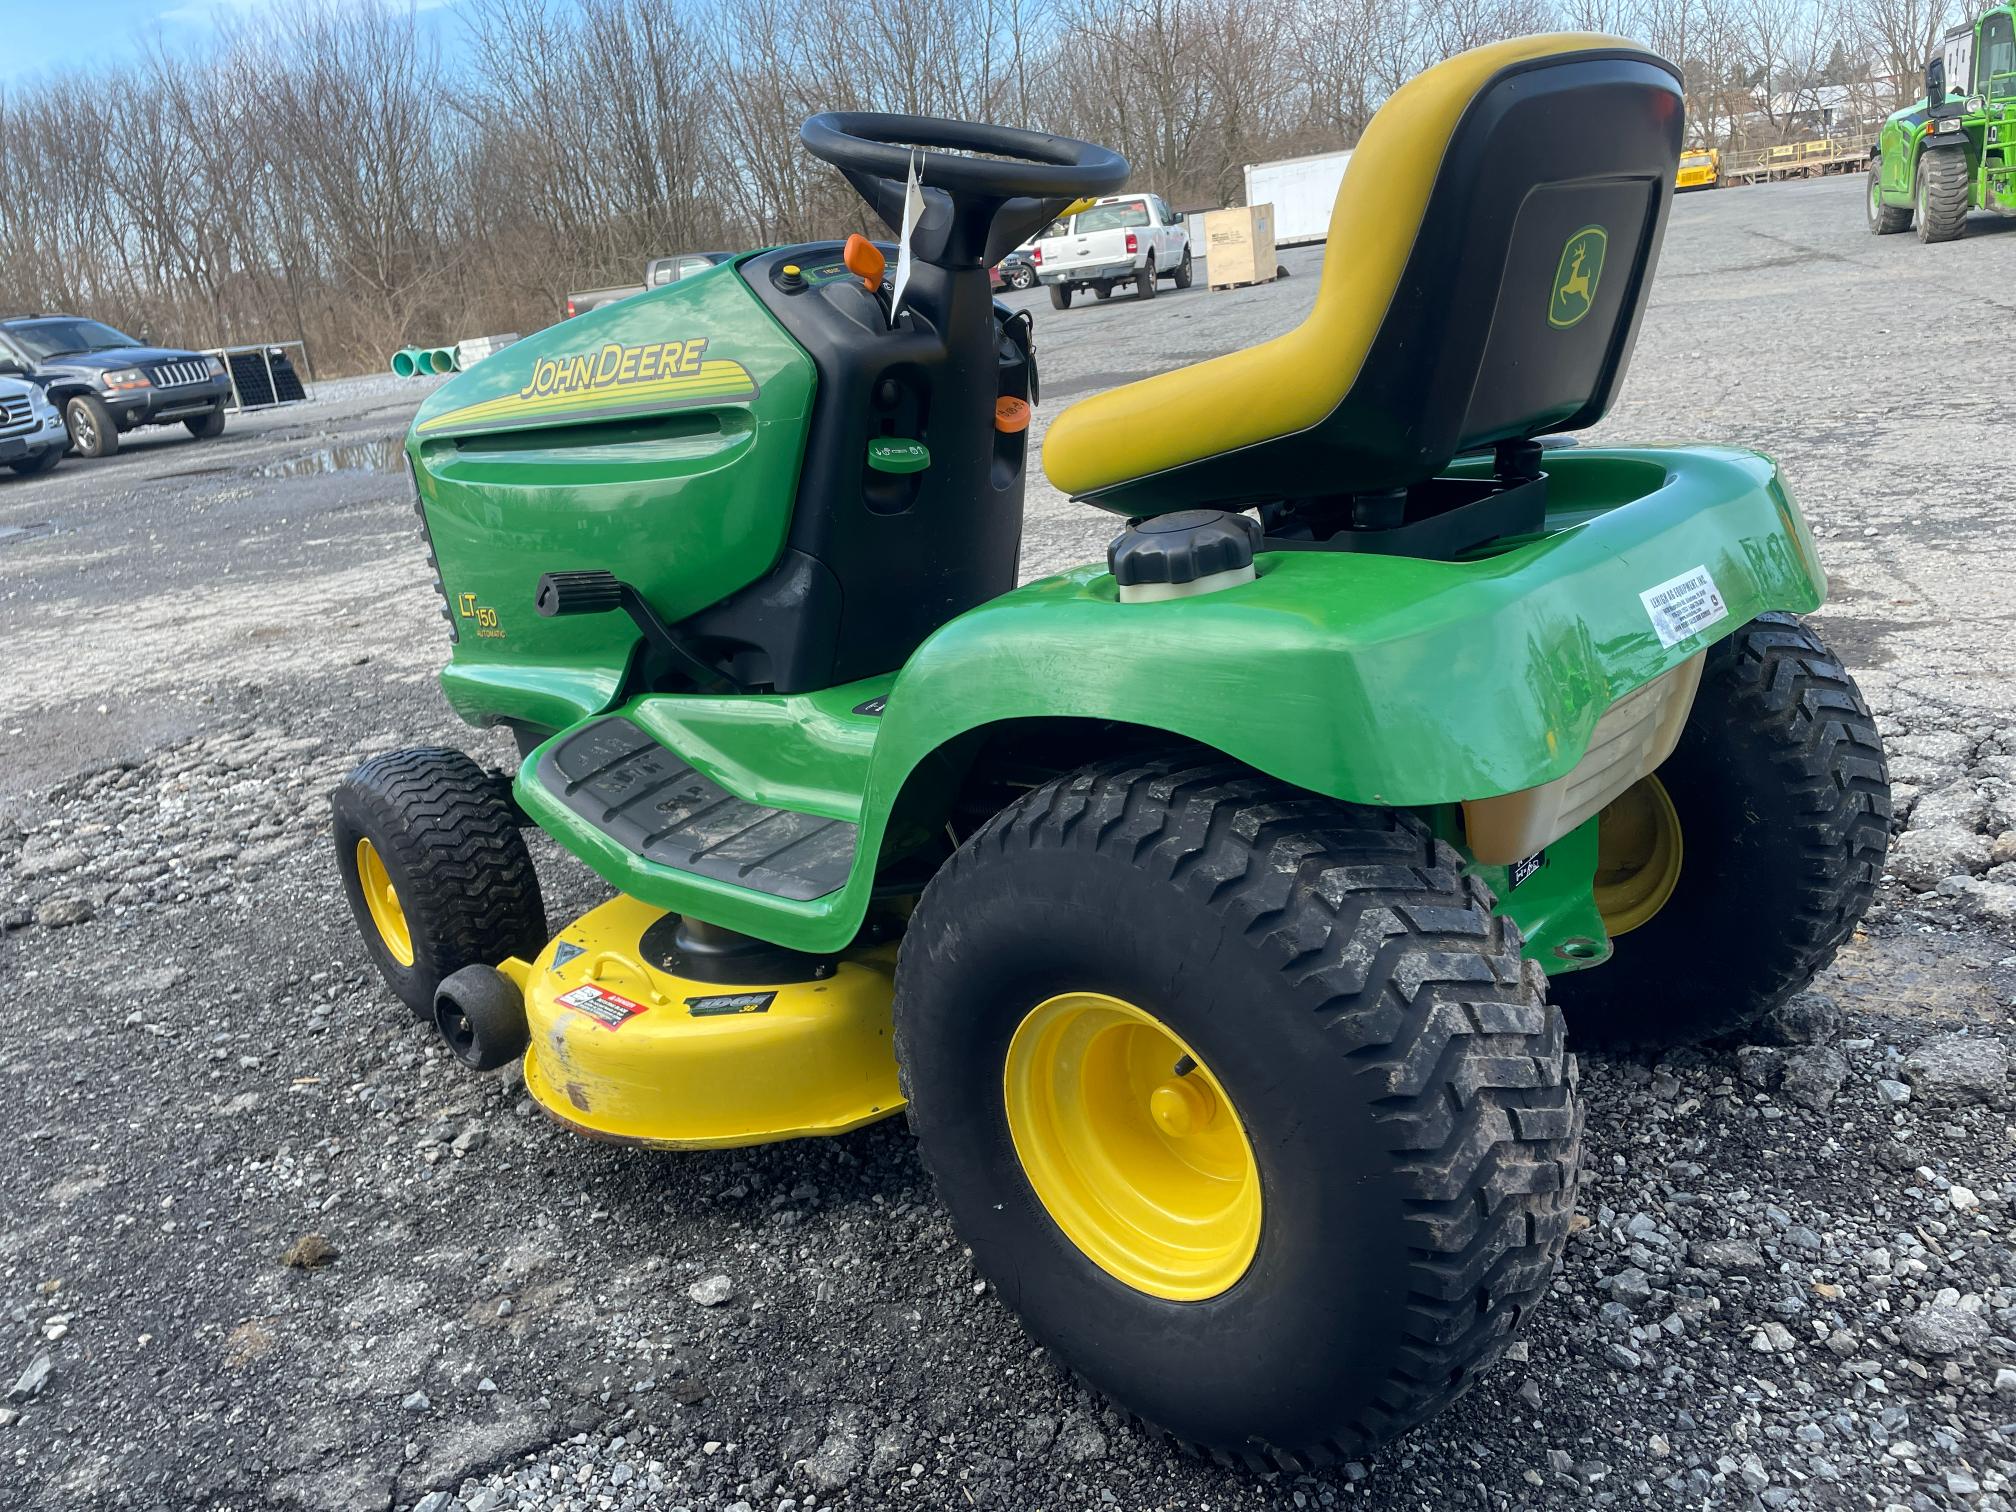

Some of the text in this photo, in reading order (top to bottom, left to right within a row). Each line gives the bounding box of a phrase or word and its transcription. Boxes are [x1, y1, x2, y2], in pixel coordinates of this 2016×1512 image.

[521, 338, 708, 399] JOHN DEERE
[458, 593, 476, 617] LT
[476, 609, 497, 627] 150
[477, 630, 506, 638] AUTOMATIC
